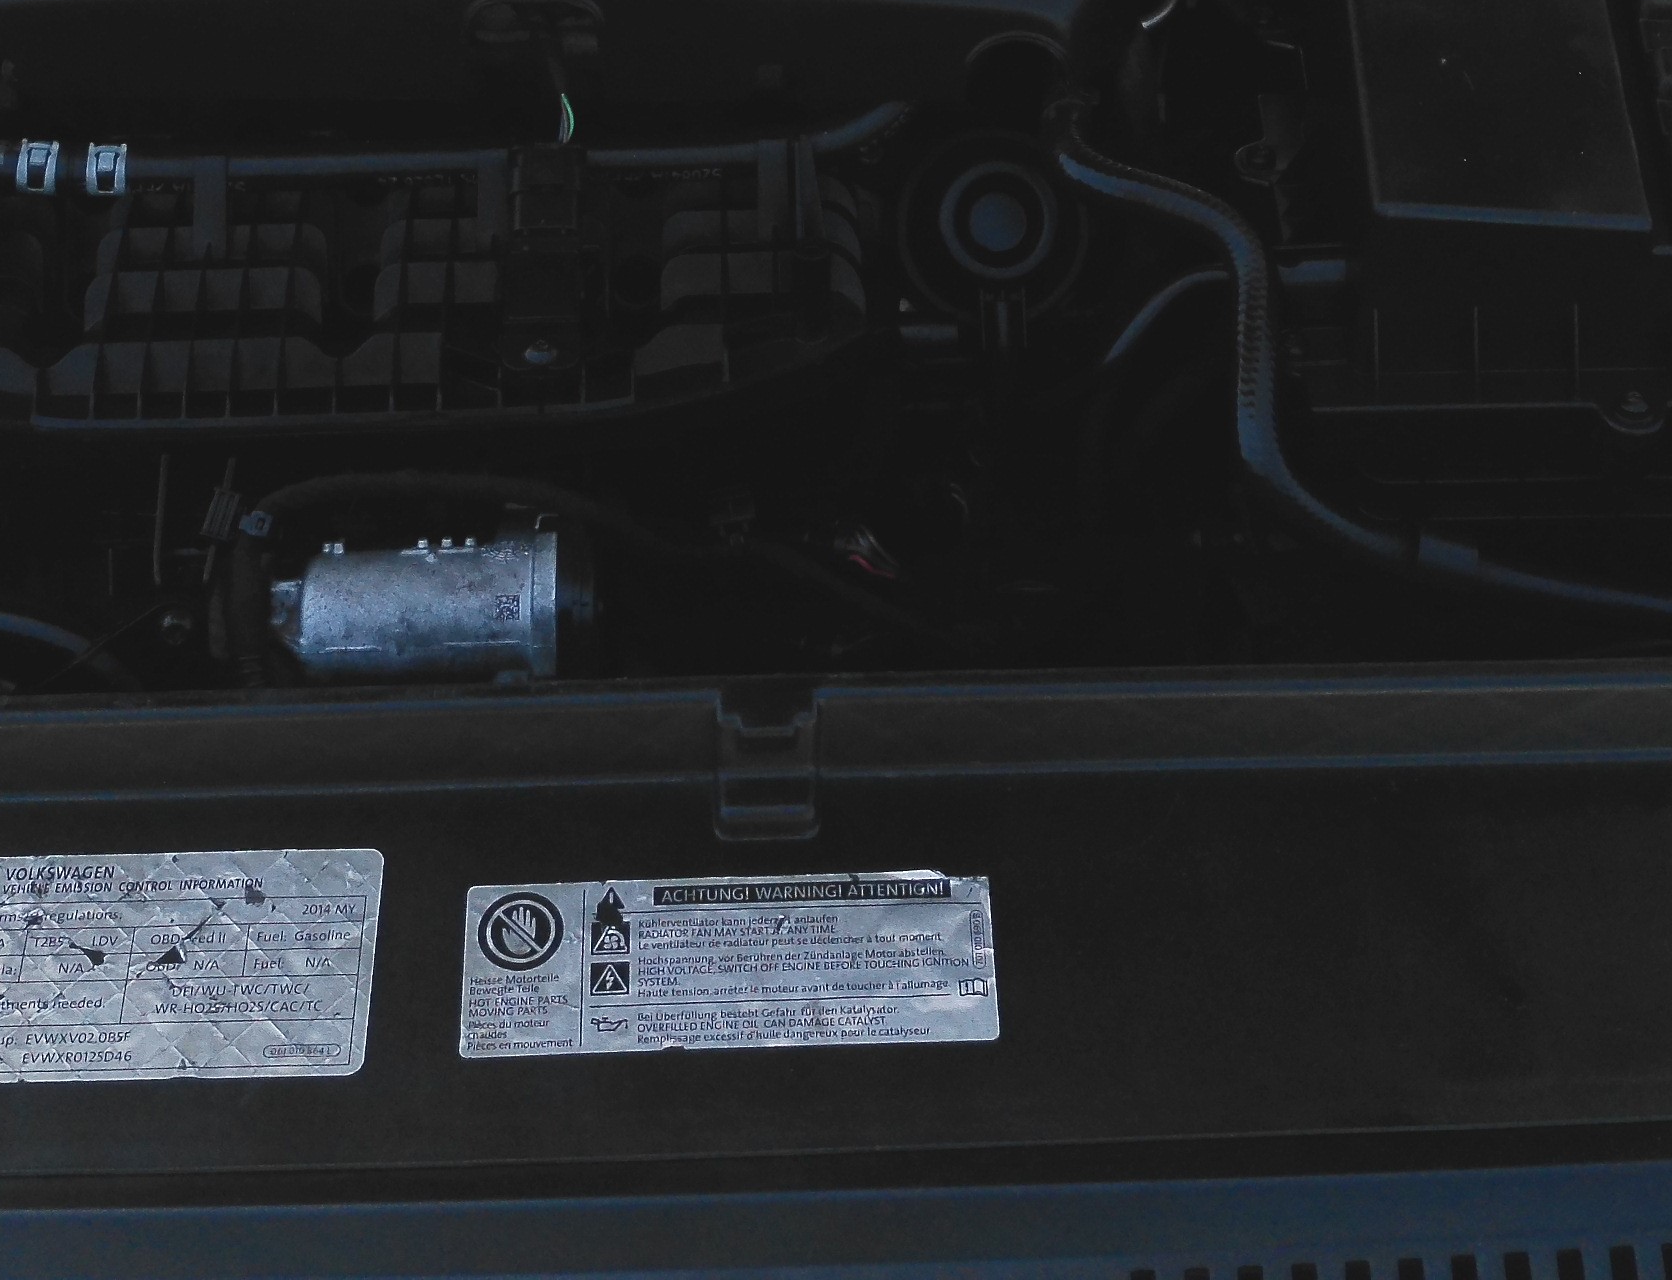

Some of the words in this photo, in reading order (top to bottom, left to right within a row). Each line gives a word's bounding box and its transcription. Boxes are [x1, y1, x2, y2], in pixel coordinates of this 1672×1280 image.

[5, 865, 115, 881] VOLKSWAGEN
[54, 881, 113, 894] EMISSION
[118, 880, 173, 892] CONTROL
[179, 877, 264, 890] INFORMATION
[661, 886, 750, 904] ACHTUNG!
[755, 883, 842, 900] WARNING!
[847, 881, 944, 897] ATTENTION!
[42, 908, 123, 922] regulations.
[301, 904, 332, 916] 2014
[334, 903, 357, 915] MY
[721, 916, 746, 927] kann
[794, 914, 838, 924] anlaufen
[256, 931, 287, 943] Fuel:
[294, 929, 351, 942] Gasoline
[638, 929, 688, 940] RADIATOR
[691, 927, 713, 938] FAN
[714, 927, 738, 937] MAY
[739, 926, 770, 936] START
[787, 925, 809, 935] ANY
[32, 936, 65, 948] T2B5
[91, 935, 119, 947] LDV
[638, 941, 651, 950] Le
[651, 939, 706, 950] ventilateur
[708, 939, 721, 948] de
[722, 937, 770, 948] radiateur
[771, 937, 796, 948] peut
[874, 933, 896, 943] tout
[898, 932, 942, 942] moment
[304, 956, 332, 969] N/A
[717, 954, 735, 964] vor
[784, 951, 801, 961] der
[803, 949, 863, 962] Zündanlage
[865, 949, 897, 959] Motor
[57, 962, 85, 976] N/A
[192, 959, 220, 971] N/A
[638, 965, 666, 976] HIGH
[717, 962, 758, 974] SWITCH
[760, 961, 779, 972] OFF
[781, 960, 821, 971] ENGINE
[823, 959, 862, 970] BEFORE
[863, 958, 920, 970] TOUCHING
[922, 956, 969, 967] IGNITION
[469, 976, 503, 986] Heisse
[504, 973, 560, 985] Motorteile
[469, 985, 515, 996] Bewegte
[517, 984, 540, 994] Teile
[637, 987, 669, 998] Haute
[713, 984, 748, 996] arrêter
[749, 984, 758, 994] le
[761, 983, 800, 994] moteur
[800, 983, 829, 993] avant
[831, 981, 845, 992] de
[846, 980, 886, 991] toucher
[51, 998, 106, 1009] needed.
[468, 998, 492, 1008] HOT
[495, 996, 535, 1007] ENGINE
[537, 994, 568, 1005] PARTS
[468, 1007, 515, 1018] MOVING
[517, 1005, 548, 1016] PARTS
[760, 1007, 796, 1018] Gefahr
[818, 1005, 838, 1016] den
[498, 1019, 512, 1029] du
[513, 1019, 550, 1029] moteur
[637, 1022, 698, 1033] OVERFILLED
[700, 1019, 740, 1031] ENGINE
[742, 1019, 758, 1029] OIL
[763, 1018, 786, 1029] CAN
[788, 1017, 835, 1028] DAMAGE
[637, 1034, 702, 1045] Remplissage
[703, 1030, 744, 1042] excessif
[746, 1030, 781, 1041] d'huile
[783, 1028, 838, 1041] dangereux
[840, 1028, 865, 1040] pour
[867, 1027, 877, 1037] le
[878, 1026, 930, 1038] catalyseur
[467, 1041, 497, 1051] Pièces
[498, 1042, 511, 1050] en
[513, 1038, 573, 1049] mouvement
[21, 1051, 132, 1065] EVWXR0125D46
